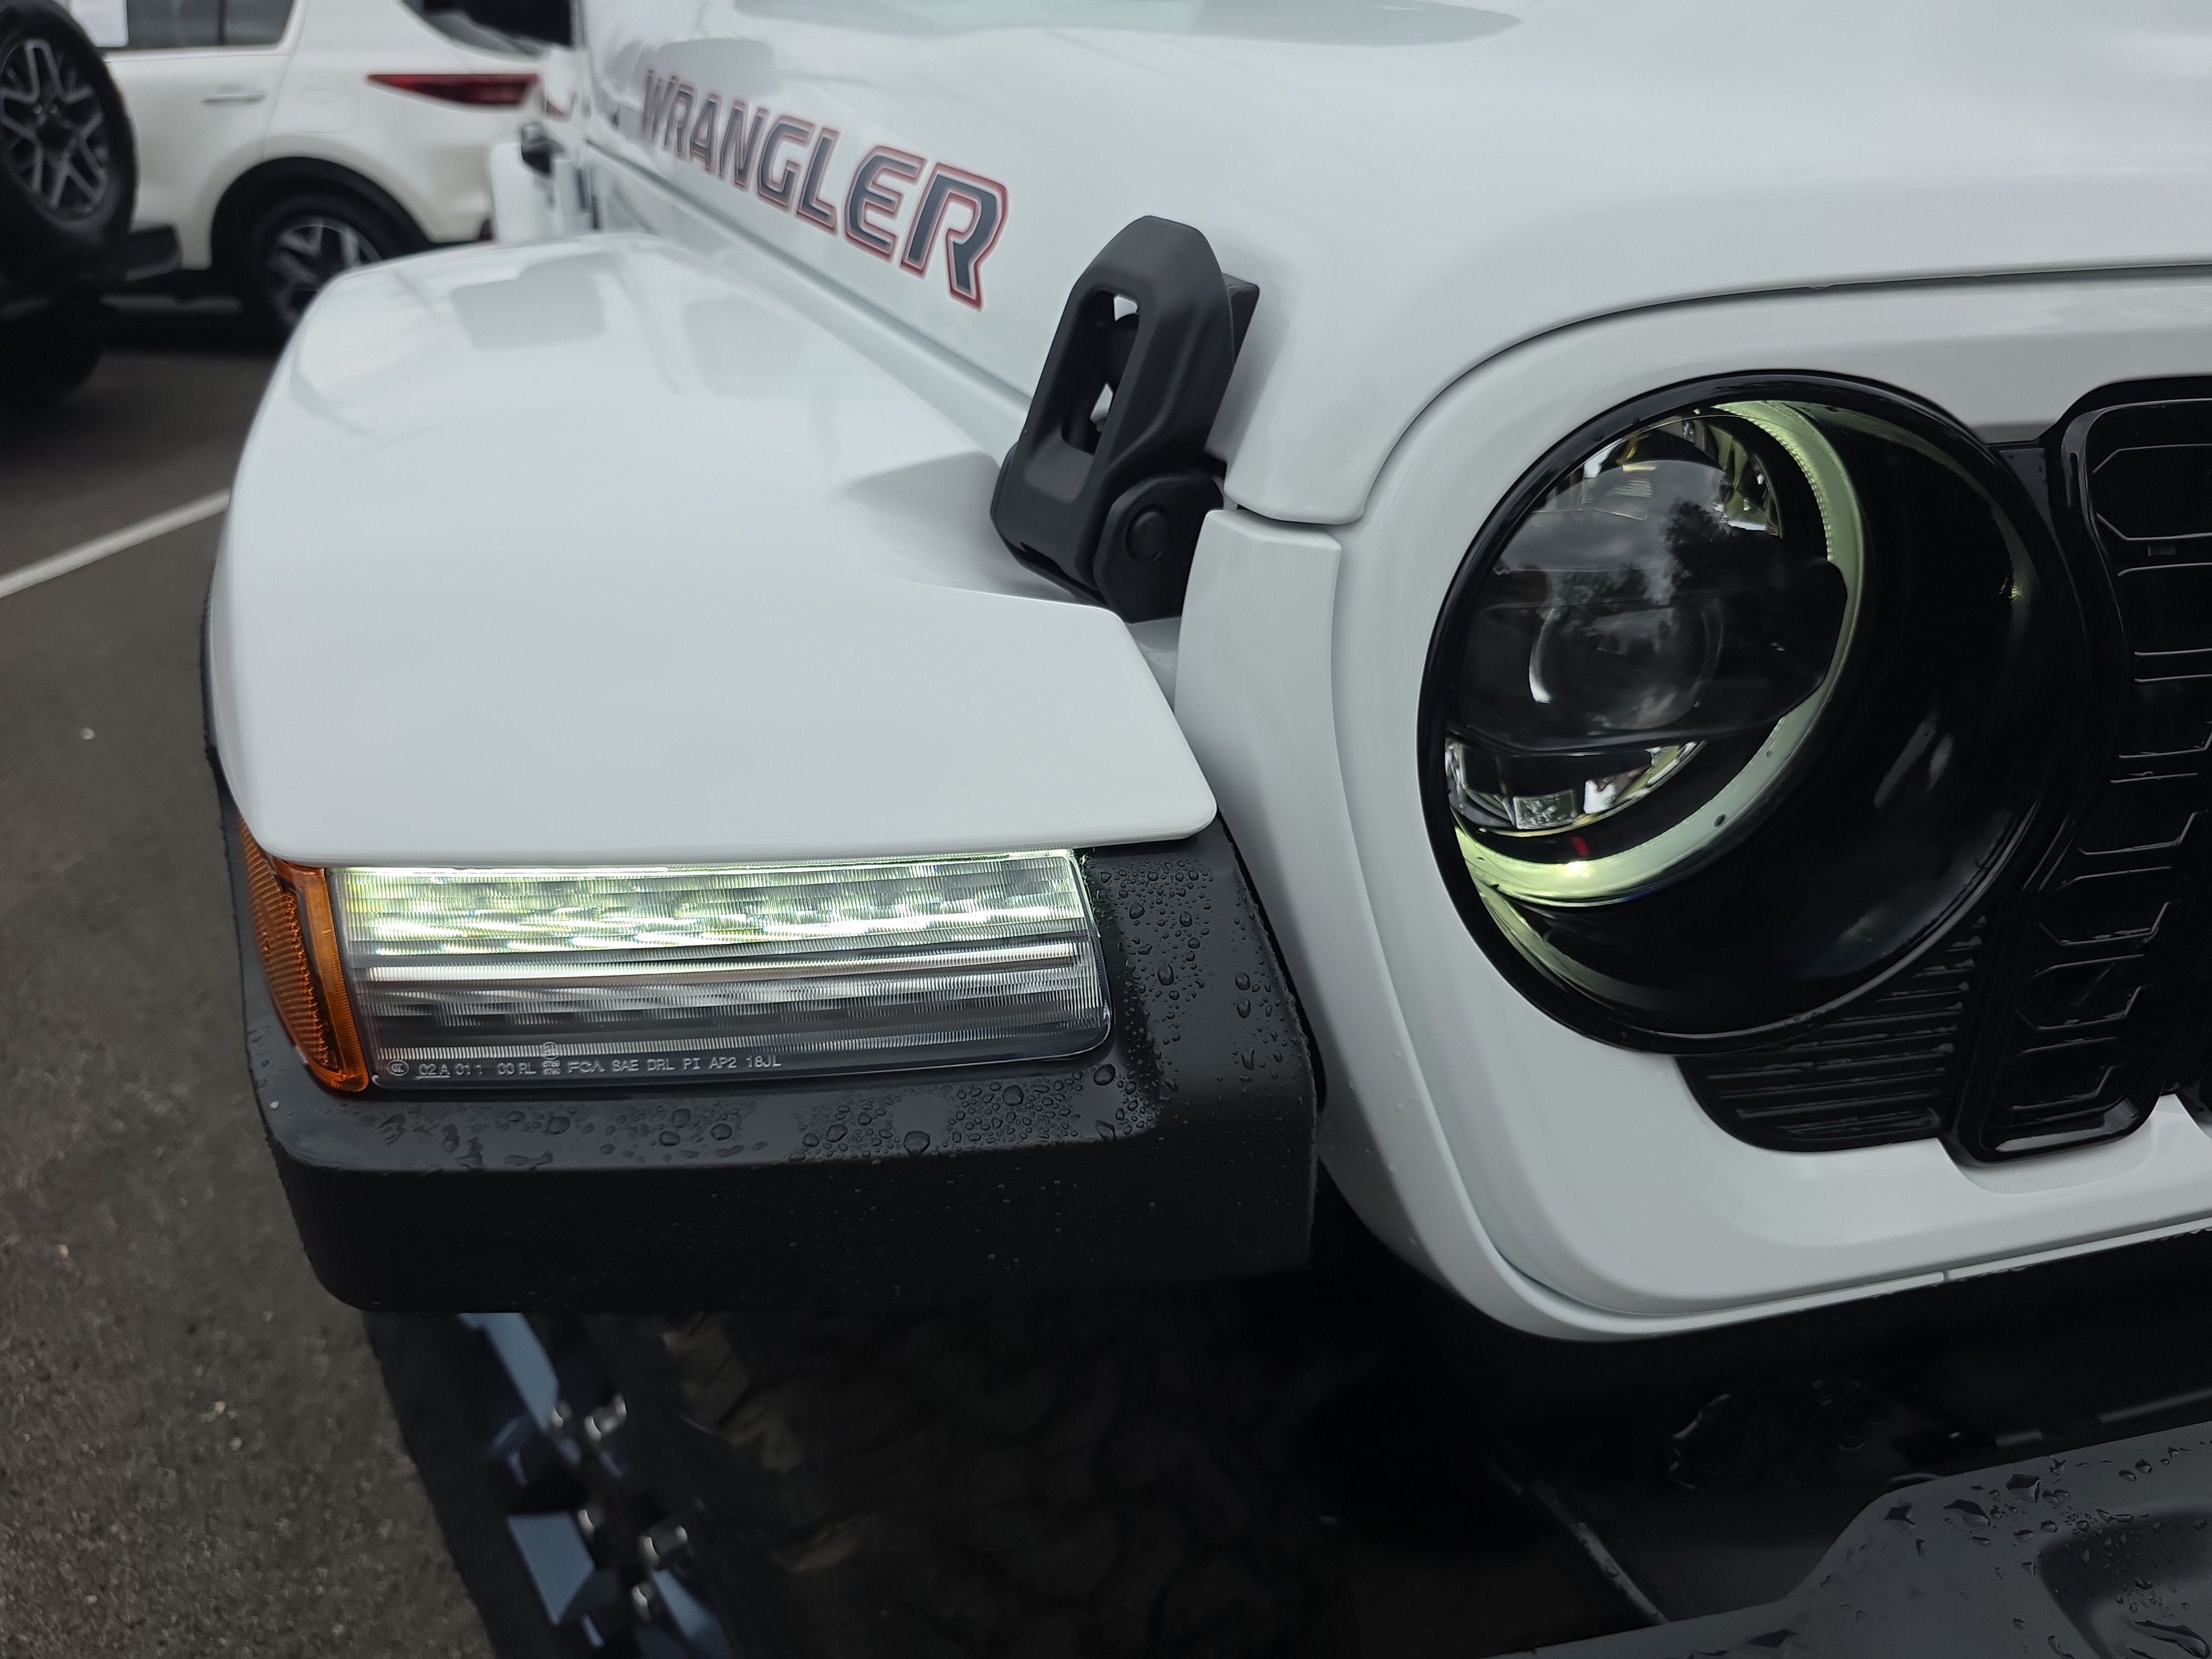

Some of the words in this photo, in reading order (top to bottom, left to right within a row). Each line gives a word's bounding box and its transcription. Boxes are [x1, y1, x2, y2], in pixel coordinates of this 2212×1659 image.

[641, 68, 1008, 311] WRANGLER
[567, 1059, 606, 1073] FCA
[612, 1059, 639, 1072] SAE
[647, 1058, 675, 1071] DRL
[709, 1057, 737, 1069] AP2
[746, 1055, 782, 1068] 18JL
